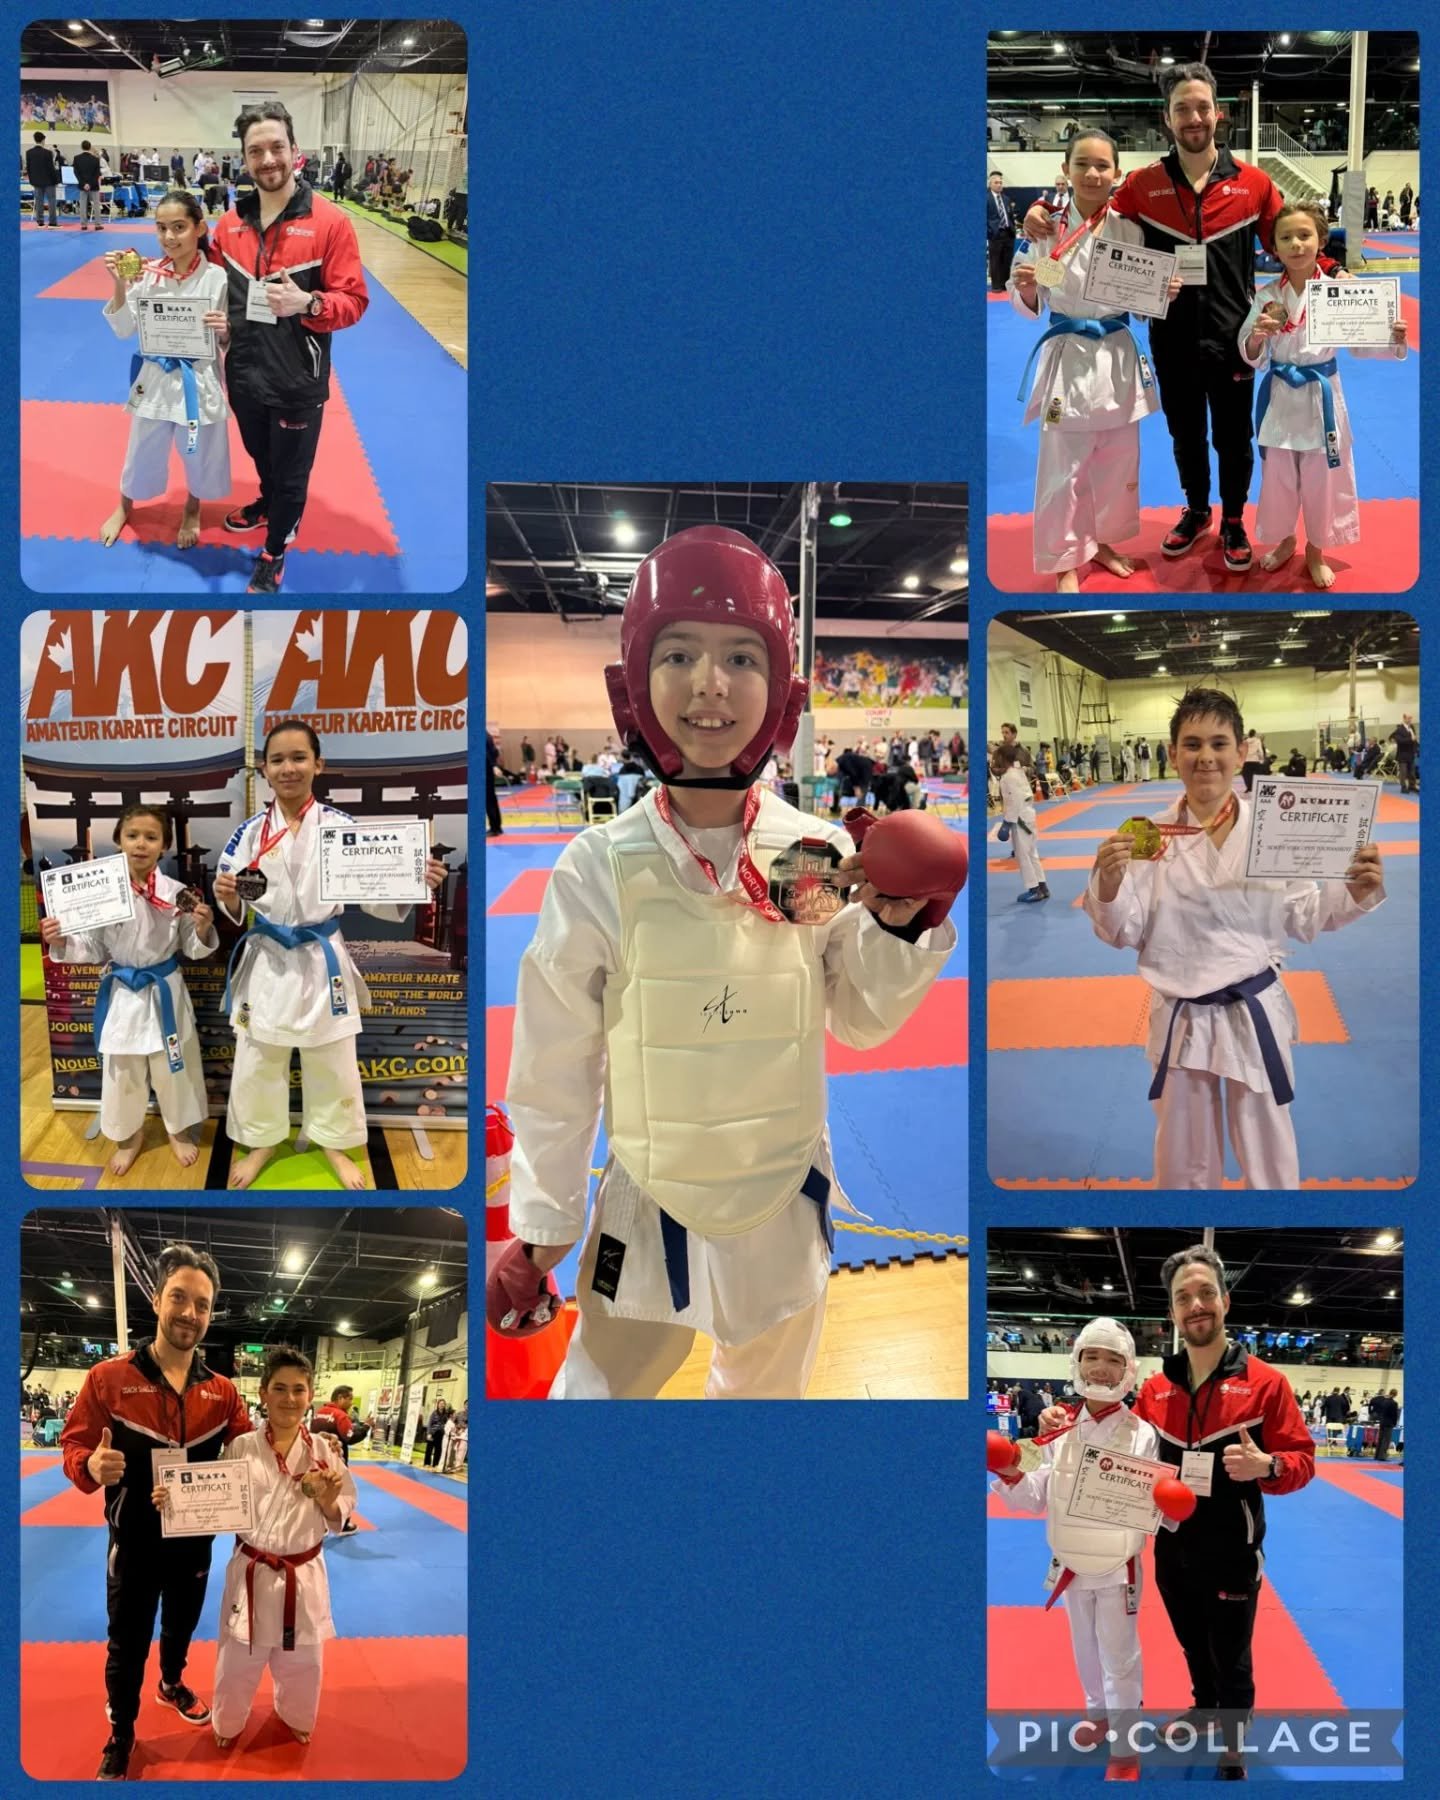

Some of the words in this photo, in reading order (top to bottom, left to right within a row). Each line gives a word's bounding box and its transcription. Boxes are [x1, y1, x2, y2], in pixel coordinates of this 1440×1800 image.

[1127, 255, 1154, 266] KATA
[1109, 261, 1156, 277] CERTIFICATE
[26, 610, 239, 718] AKC
[264, 610, 468, 710] AKC
[347, 711, 417, 733] KARATE
[420, 709, 468, 731] CIRC
[26, 719, 99, 742] AMATEUR
[101, 718, 165, 740] KARATE
[168, 716, 237, 738] CIRCUIT
[1299, 797, 1350, 806] KUMITE
[1279, 811, 1349, 824] CERTIFICATE
[362, 834, 398, 842] KATA
[342, 846, 403, 856] CERTIFICATE
[77, 869, 104, 879] KATA
[62, 877, 109, 894] CERTIFICATE
[740, 863, 765, 899] NORTH
[363, 973, 413, 983] AMATEUR
[416, 973, 460, 984] KARATE
[68, 982, 100, 990] CANAD
[404, 990, 425, 999] THE
[428, 991, 463, 1000] WORLD
[360, 1006, 388, 1015] RIGHT
[392, 1006, 427, 1016] HANDS
[50, 1022, 95, 1033] JOIGNE
[197, 1472, 227, 1480] KATA
[1116, 1464, 1154, 1478] KUMITE
[1099, 1472, 1153, 1491] CERTIFICATE
[181, 1483, 232, 1494] CERTIFICATE
